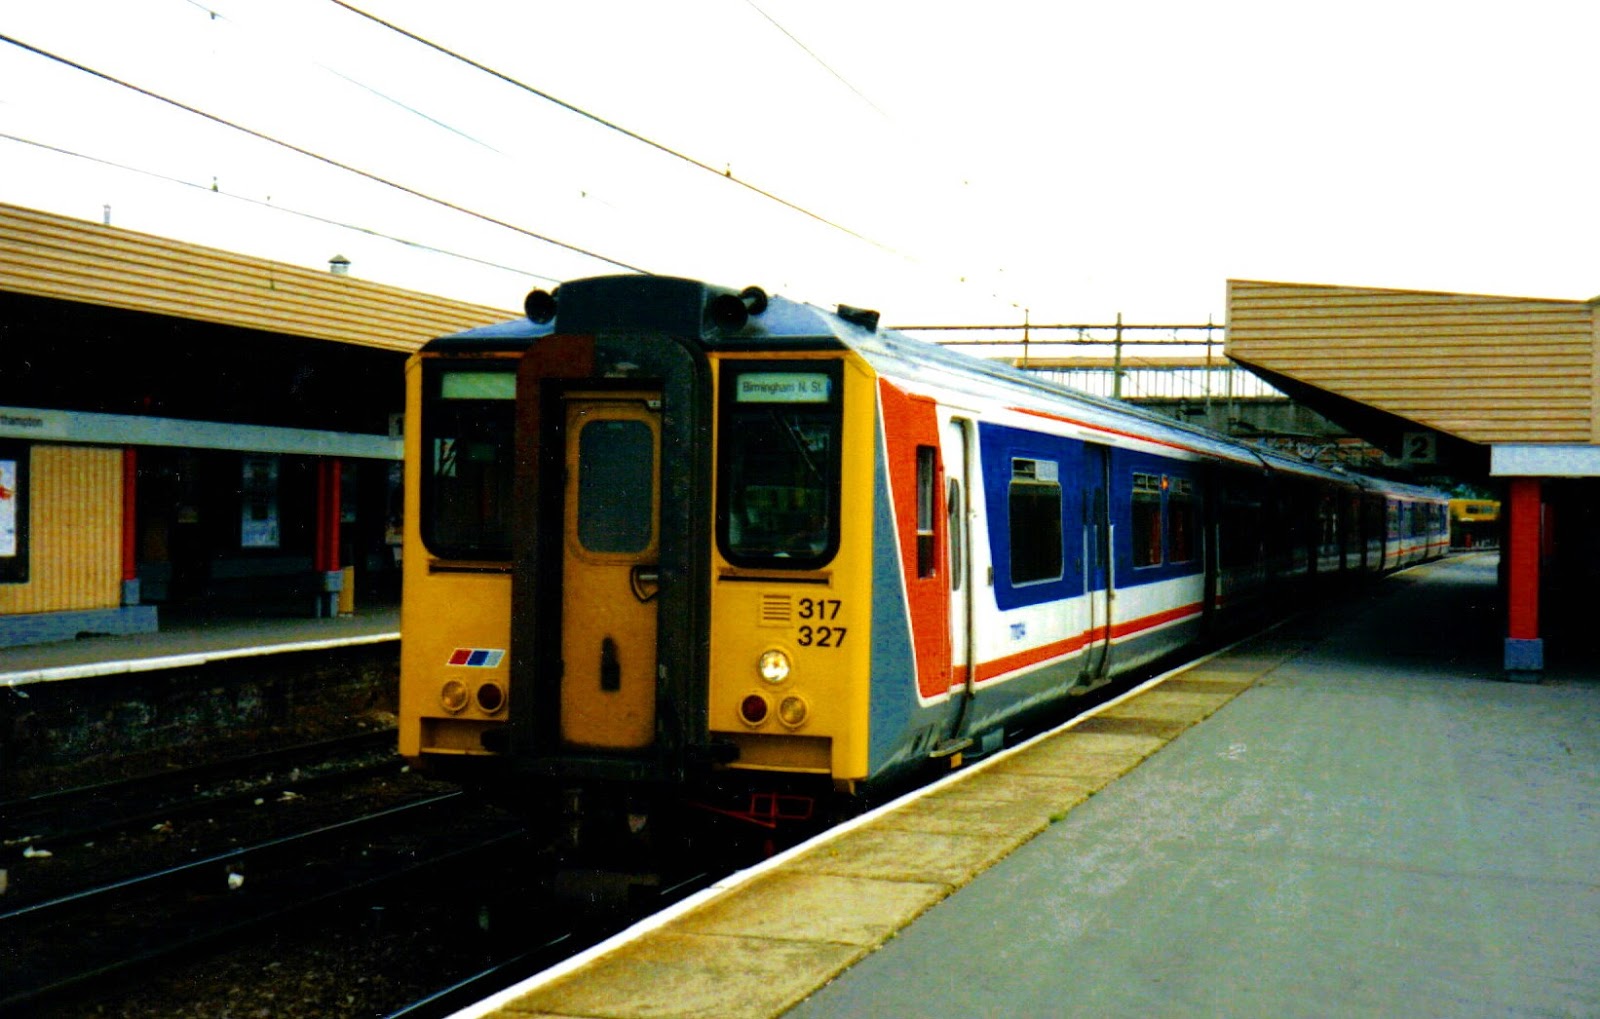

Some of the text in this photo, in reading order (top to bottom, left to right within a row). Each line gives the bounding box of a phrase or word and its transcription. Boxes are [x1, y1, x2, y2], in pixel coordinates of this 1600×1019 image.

[742, 381, 795, 395] Birmingham
[1410, 436, 1428, 458] 2
[798, 597, 842, 620] 317
[797, 625, 847, 648] 327
